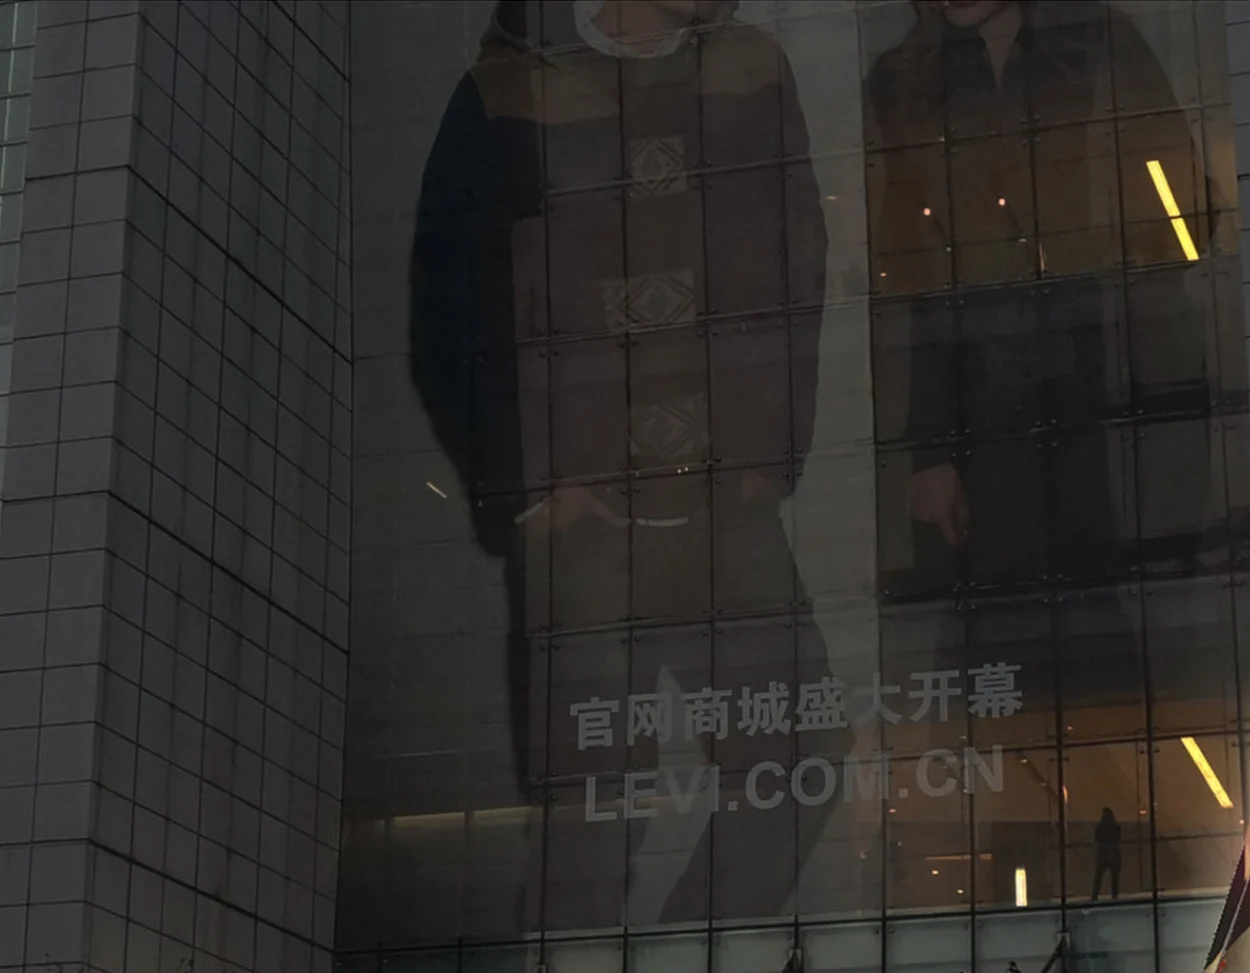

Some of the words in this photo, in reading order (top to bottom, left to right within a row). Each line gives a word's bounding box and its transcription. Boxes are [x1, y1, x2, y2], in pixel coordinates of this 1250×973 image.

[570, 662, 1024, 750] 官网商城盛大开幕
[584, 744, 1005, 822] LEVI.COM.CN
